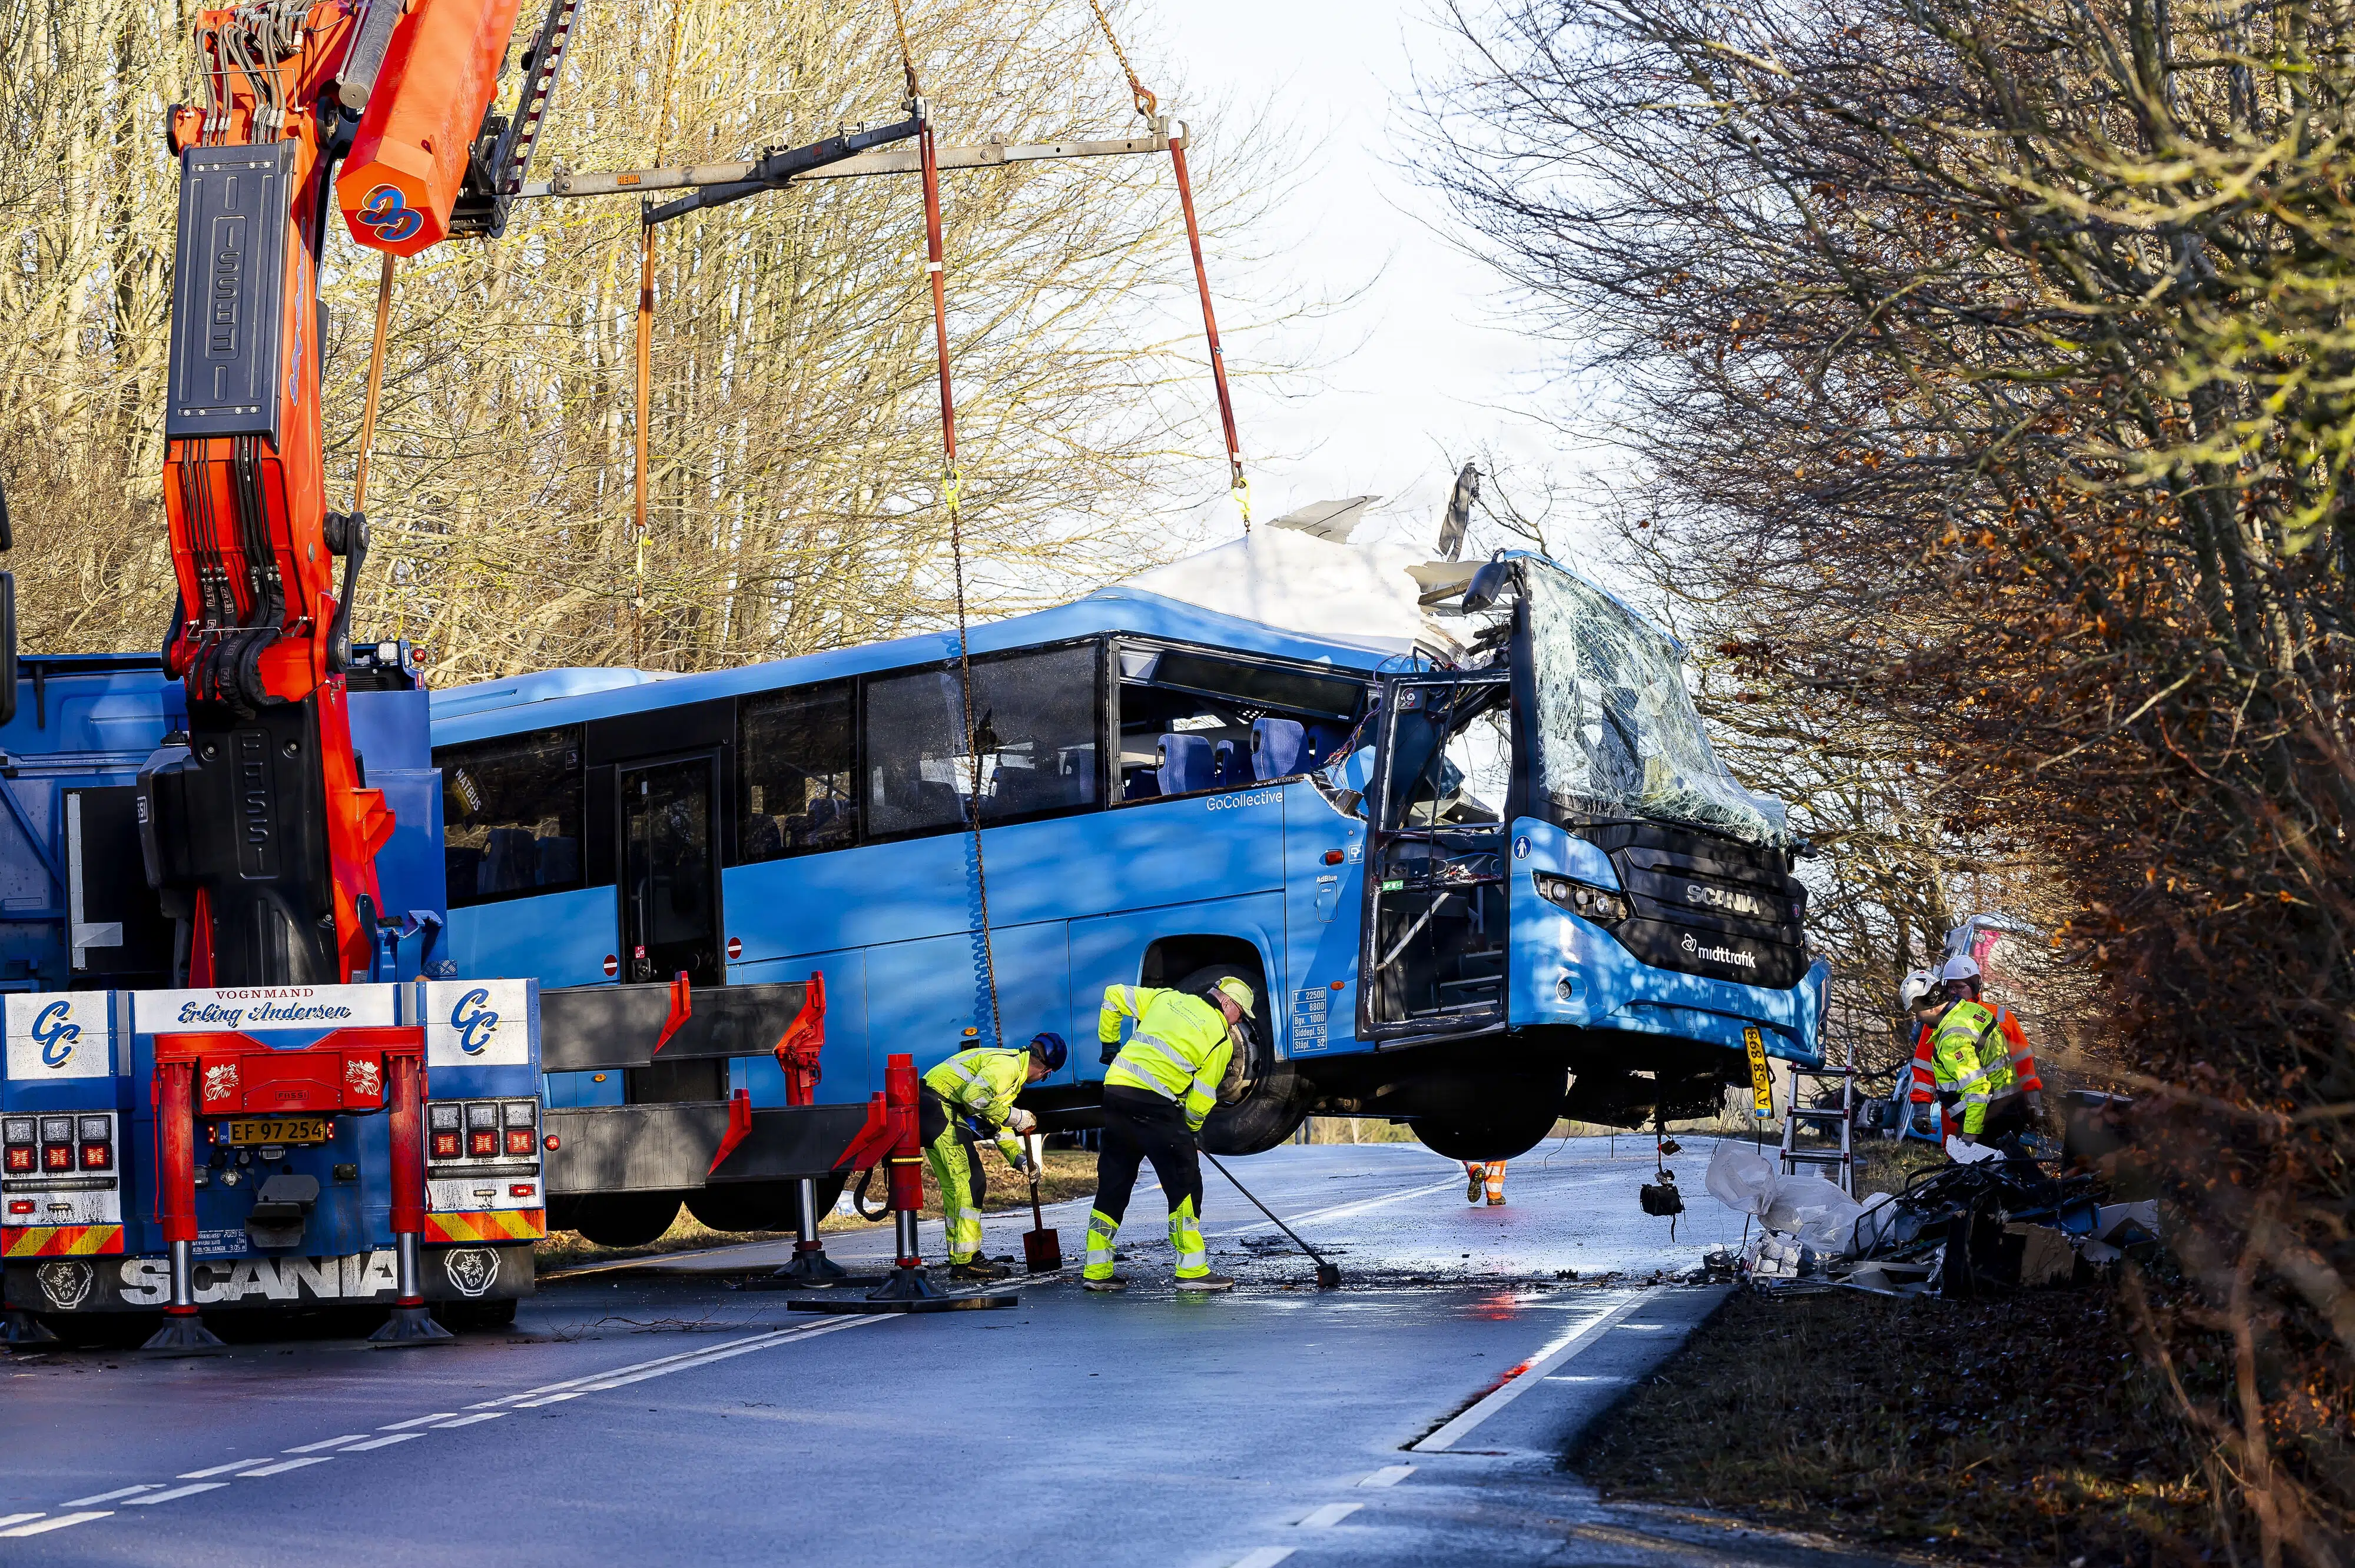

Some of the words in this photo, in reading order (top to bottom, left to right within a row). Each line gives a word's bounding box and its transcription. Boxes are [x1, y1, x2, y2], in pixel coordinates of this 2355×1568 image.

[617, 174, 641, 185] HEMA
[213, 225, 240, 351] FASSI
[456, 768, 482, 811] NATBUS
[240, 733, 268, 872] FASSI
[1207, 790, 1283, 811] GoCollective
[1686, 885, 1759, 915] SCANIA
[1698, 946, 1756, 968] midttrafik
[215, 988, 314, 999] VOGNMAND
[1294, 992, 1299, 1001] T.
[1306, 990, 1324, 1000] 22500
[177, 1001, 247, 1028] Erling
[248, 1002, 352, 1021] Andersen
[1309, 1002, 1324, 1011] 8800
[1295, 1016, 1306, 1026] Bgv.
[1309, 1014, 1325, 1023] 1000
[1295, 1027, 1316, 1037] Siddepl.
[1317, 1026, 1325, 1035] 55
[1295, 1040, 1310, 1050] Ståpl.
[1317, 1038, 1325, 1047] 52
[1747, 1031, 1762, 1059] 898
[1753, 1063, 1766, 1082] 58
[1756, 1087, 1768, 1106] AY
[231, 1124, 255, 1141] EF
[261, 1122, 283, 1141] 97
[288, 1121, 323, 1139] 254
[120, 1250, 398, 1304] SCANIA
